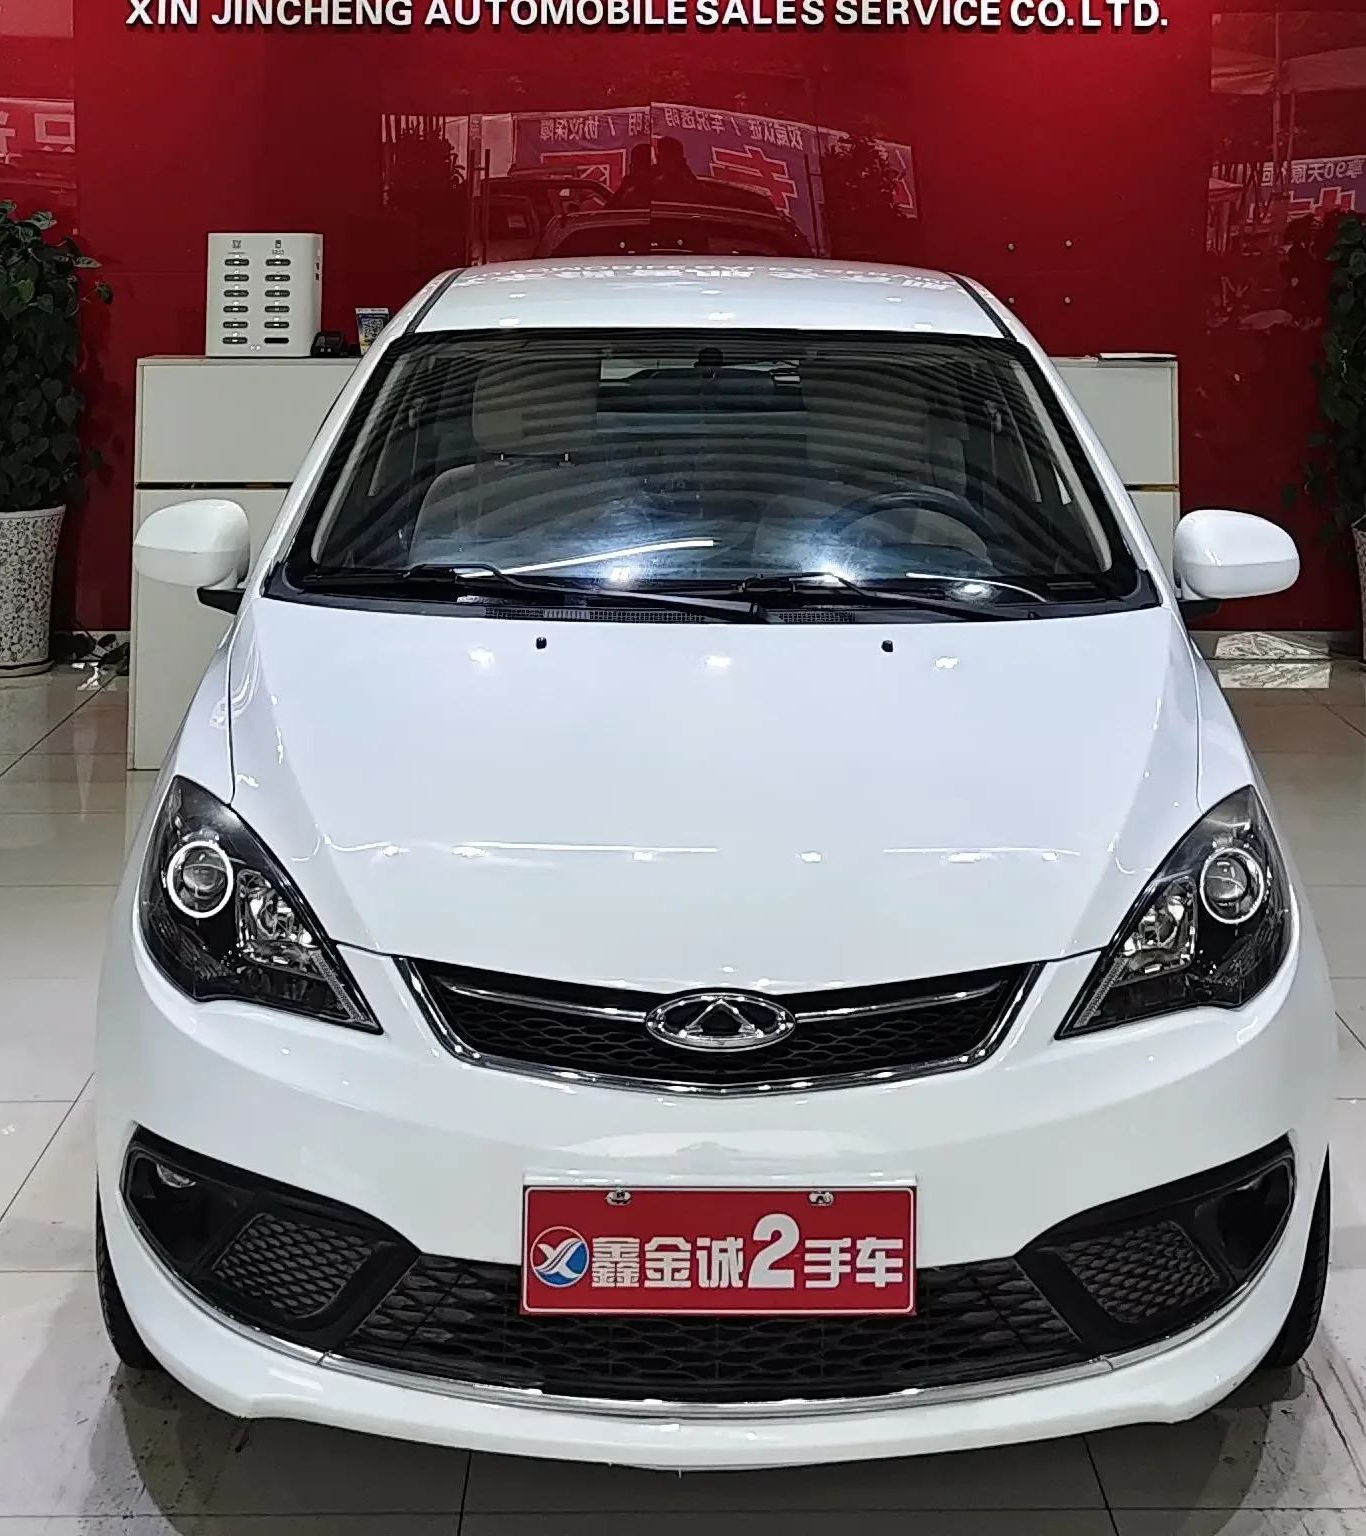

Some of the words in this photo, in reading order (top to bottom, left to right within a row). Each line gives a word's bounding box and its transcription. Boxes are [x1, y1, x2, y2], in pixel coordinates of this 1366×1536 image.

[591, 1212, 904, 1289] 鑫金诚2手车
